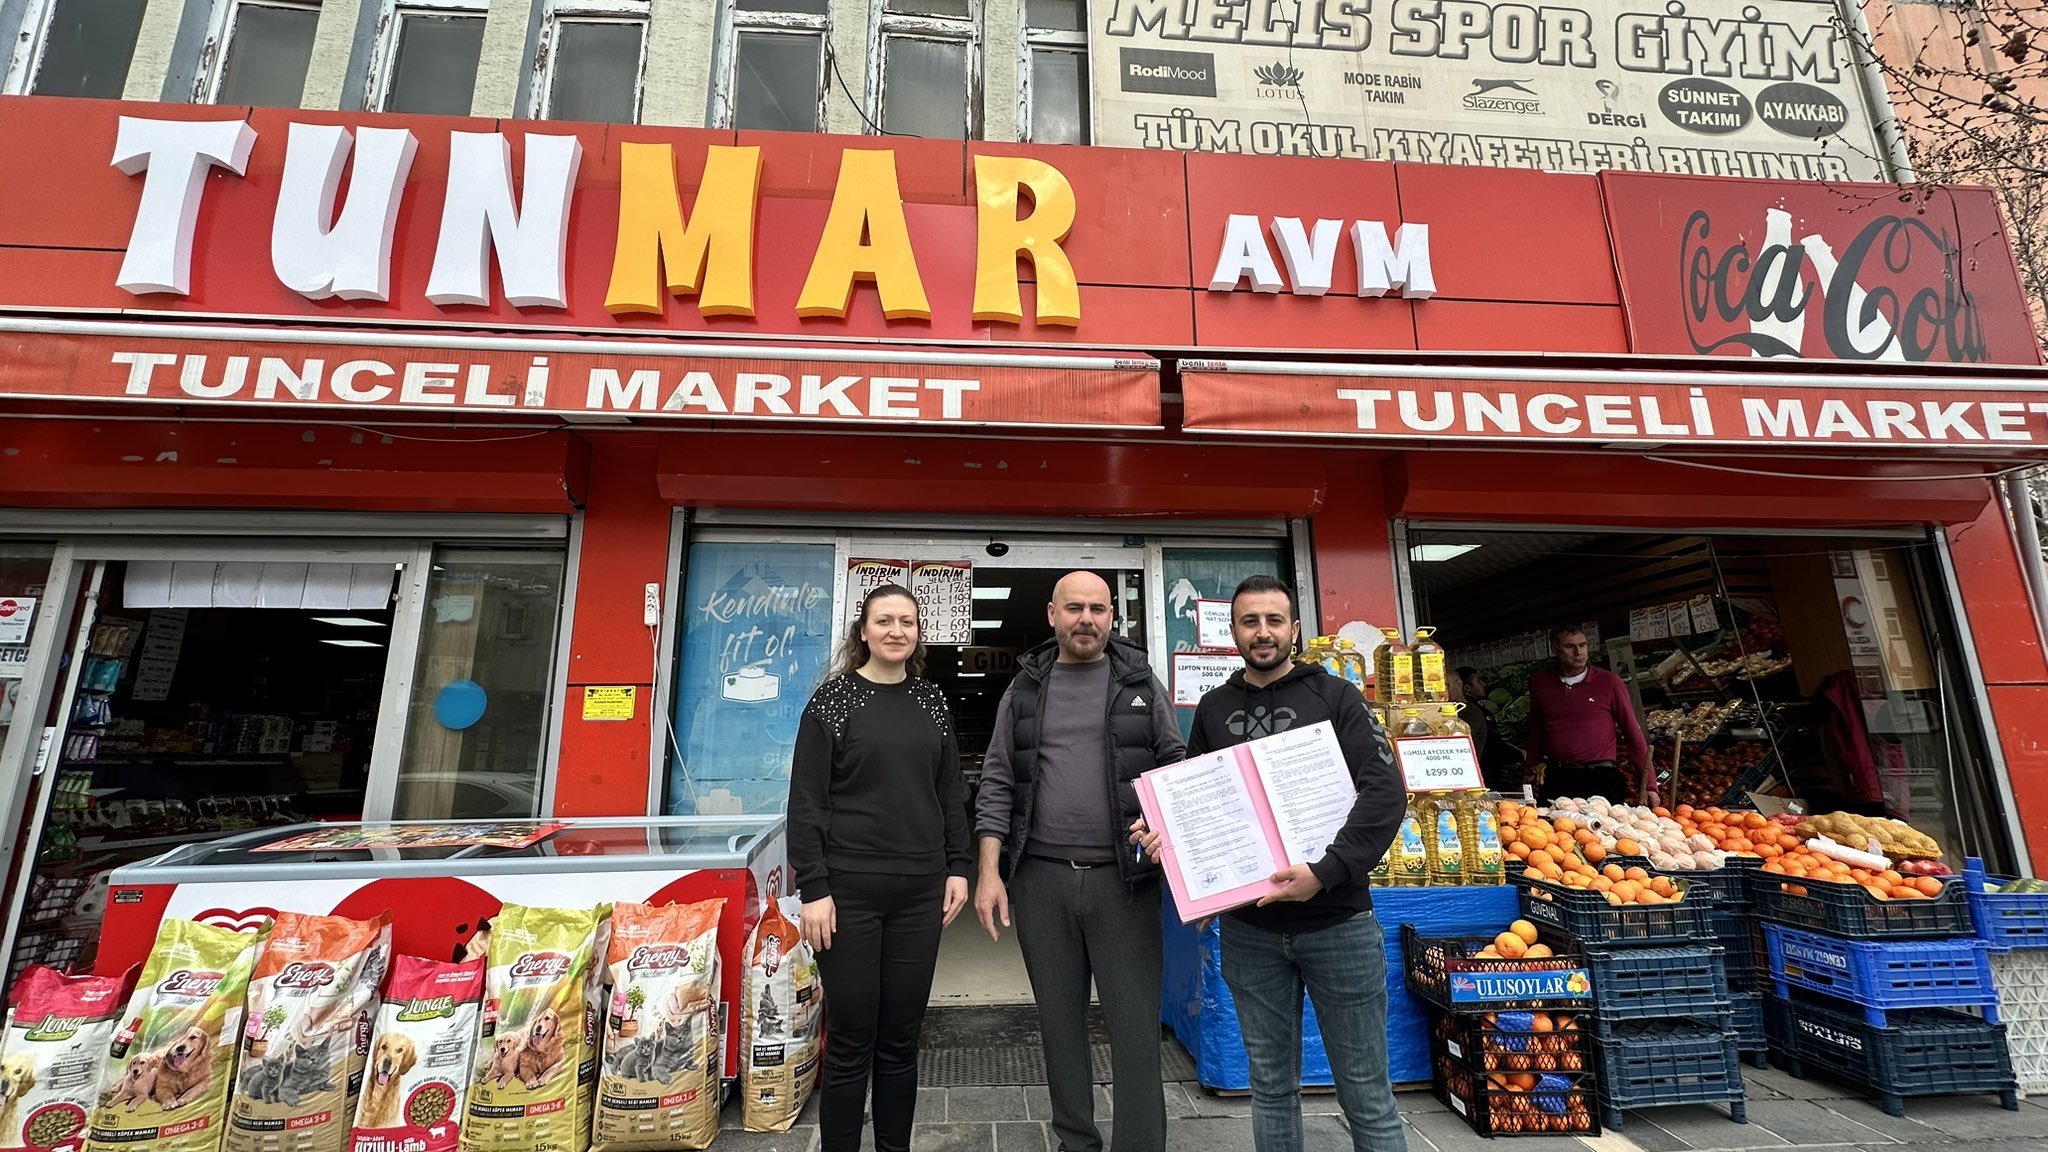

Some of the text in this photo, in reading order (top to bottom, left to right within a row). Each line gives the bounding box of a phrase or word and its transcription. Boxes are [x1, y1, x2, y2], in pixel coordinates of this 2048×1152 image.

[1390, 0, 1597, 68] SPOR
[1615, 0, 1840, 84] GİYİM
[1129, 63, 1206, 81] RodiMood
[1344, 71, 1422, 89] MODE RABİN
[1256, 87, 1305, 101] LOTUS
[1365, 89, 1405, 104] TAKIM
[1667, 86, 1742, 107] SÜNNET
[1463, 94, 1541, 115] Slazenger
[1763, 102, 1845, 123] AYAKKABI
[1587, 110, 1647, 128] DERGİ
[1677, 109, 1742, 127] TAKIMI
[1134, 107, 1242, 153] TÜM
[1250, 122, 1368, 159] OKUL
[1374, 127, 1651, 172] KIYAFETLERİ
[1208, 213, 1437, 300] AVM
[111, 352, 980, 419] TUNCELİ MARKET
[1336, 387, 1716, 436] TUNCELİ
[698, 582, 819, 624] Kendinle
[917, 596, 930, 605] 00
[720, 625, 764, 673] fit
[628, 946, 690, 974] Energy
[767, 933, 782, 977] Energy
[510, 953, 572, 978] Energy
[1476, 976, 1565, 996] ULUSOYLAR
[404, 996, 452, 1015] JUNGLE
[529, 1103, 550, 1114] OMEGA
[663, 1095, 683, 1106] OMEGA
[164, 1124, 190, 1135] OMEGA
[290, 1113, 326, 1127] OMEGA 3-6
